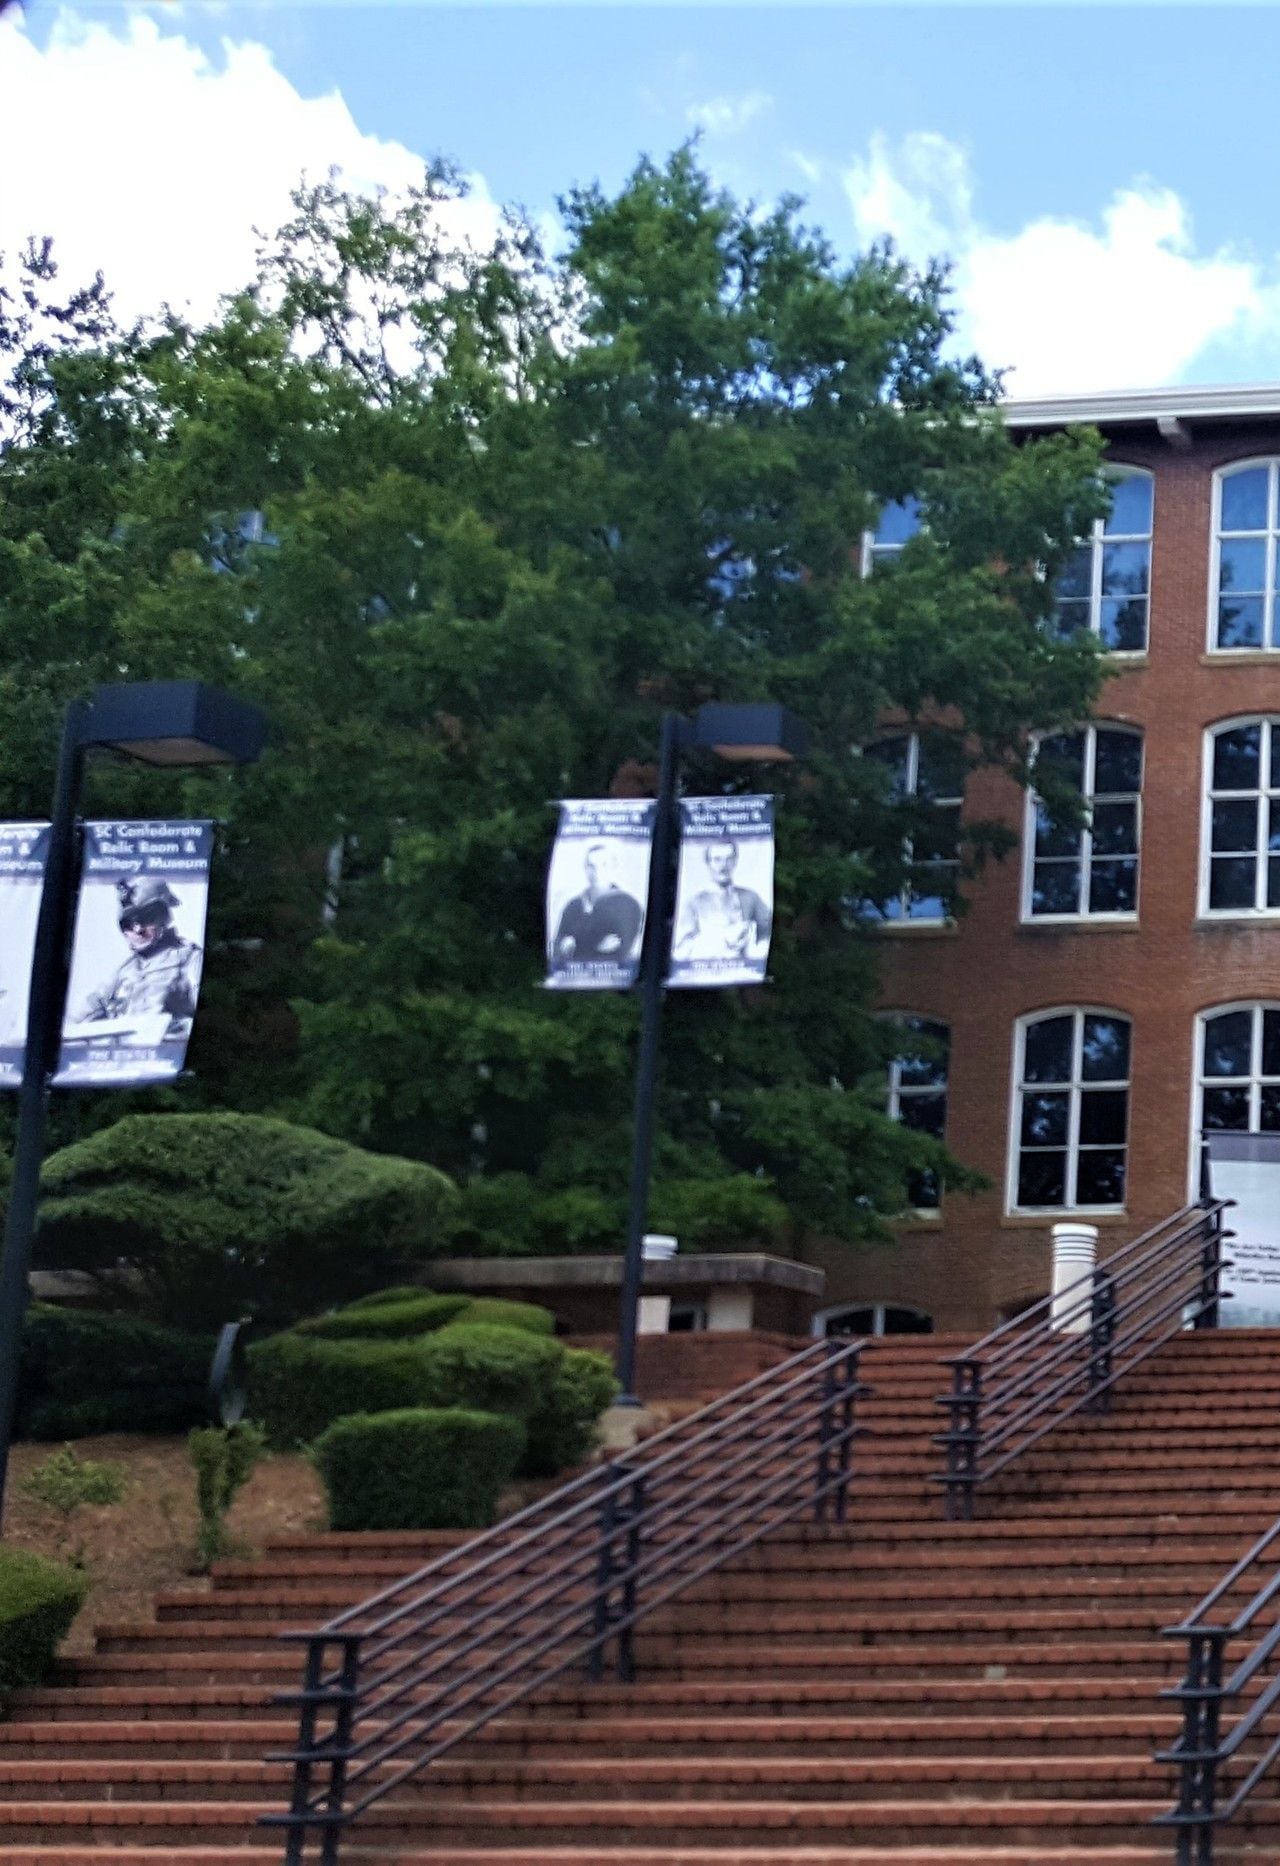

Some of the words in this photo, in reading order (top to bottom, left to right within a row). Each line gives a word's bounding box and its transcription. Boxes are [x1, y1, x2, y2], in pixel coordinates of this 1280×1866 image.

[95, 824, 113, 838] SC
[116, 823, 203, 838] Confederate
[101, 841, 134, 854] Relic
[139, 840, 179, 853] Room
[89, 856, 143, 872] Military
[147, 856, 209, 870] Museum
